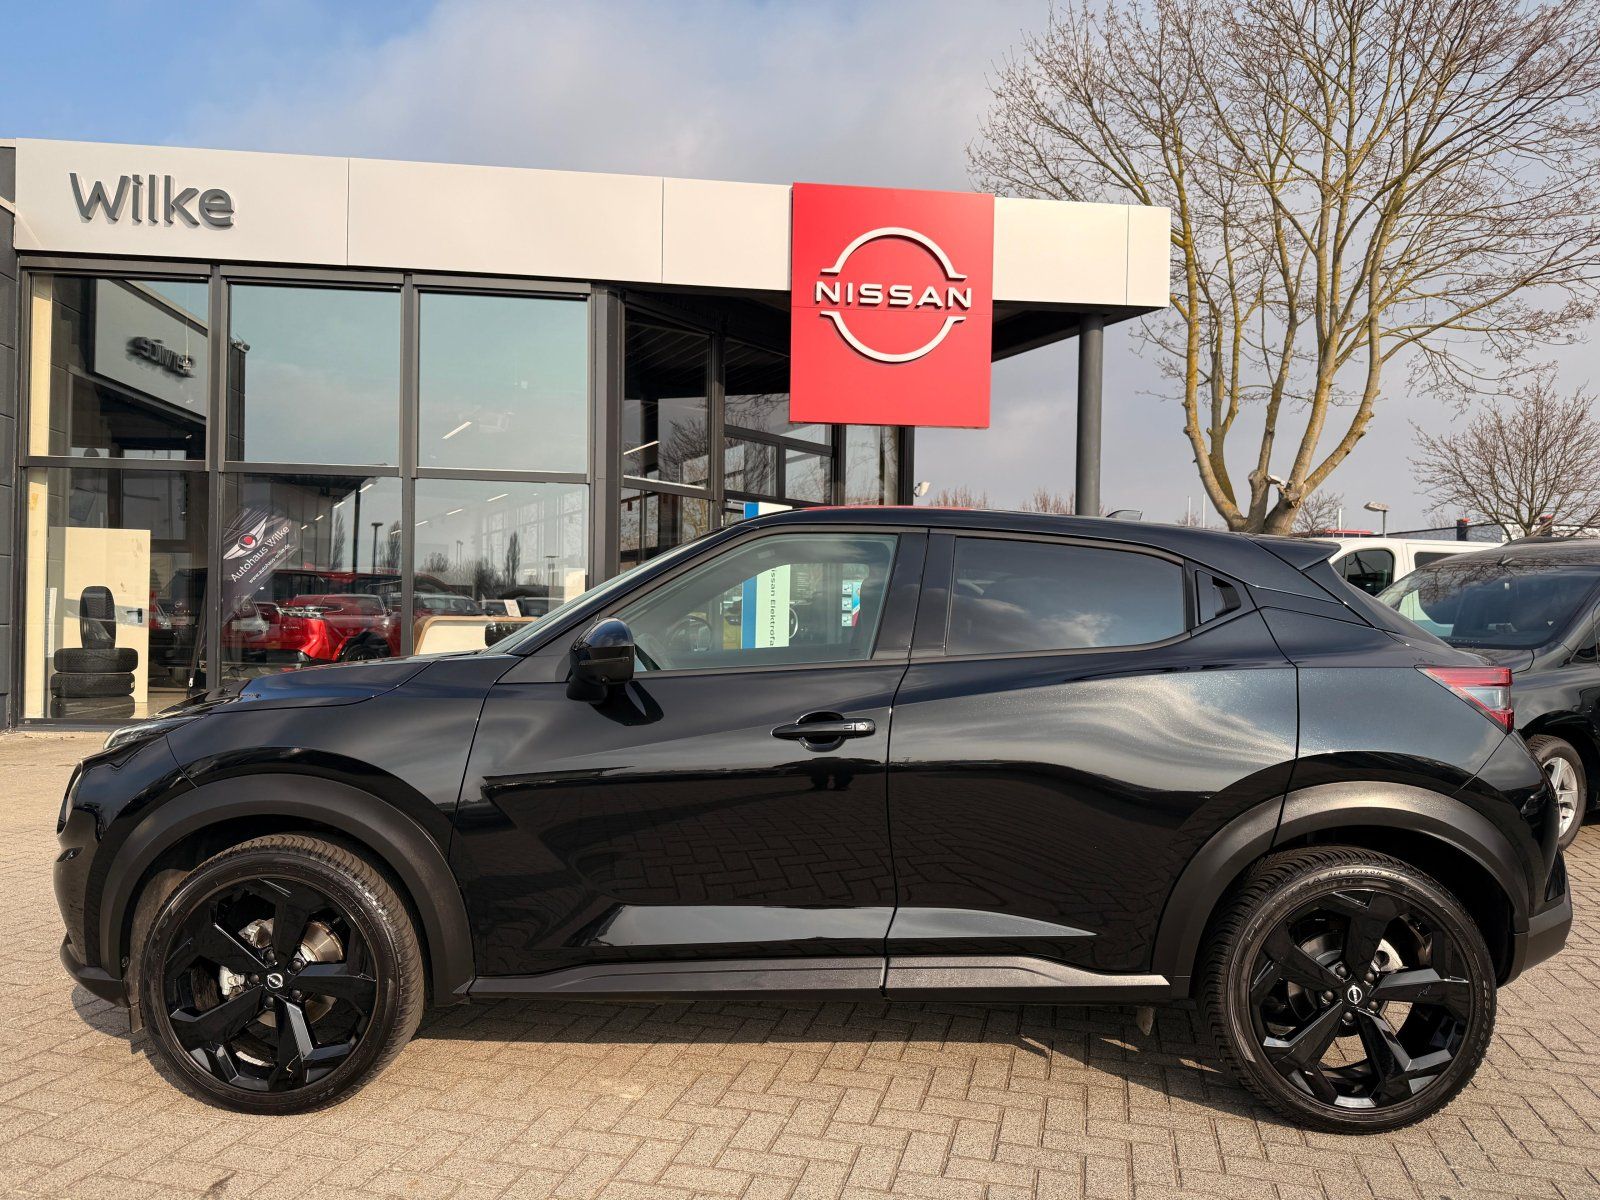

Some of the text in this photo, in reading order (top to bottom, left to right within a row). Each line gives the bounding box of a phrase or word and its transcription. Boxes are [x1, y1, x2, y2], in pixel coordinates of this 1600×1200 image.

[69, 172, 235, 228] Wilke
[815, 281, 972, 310] NISSAN
[231, 545, 269, 582] Autohaus
[264, 525, 290, 547] Wilke
